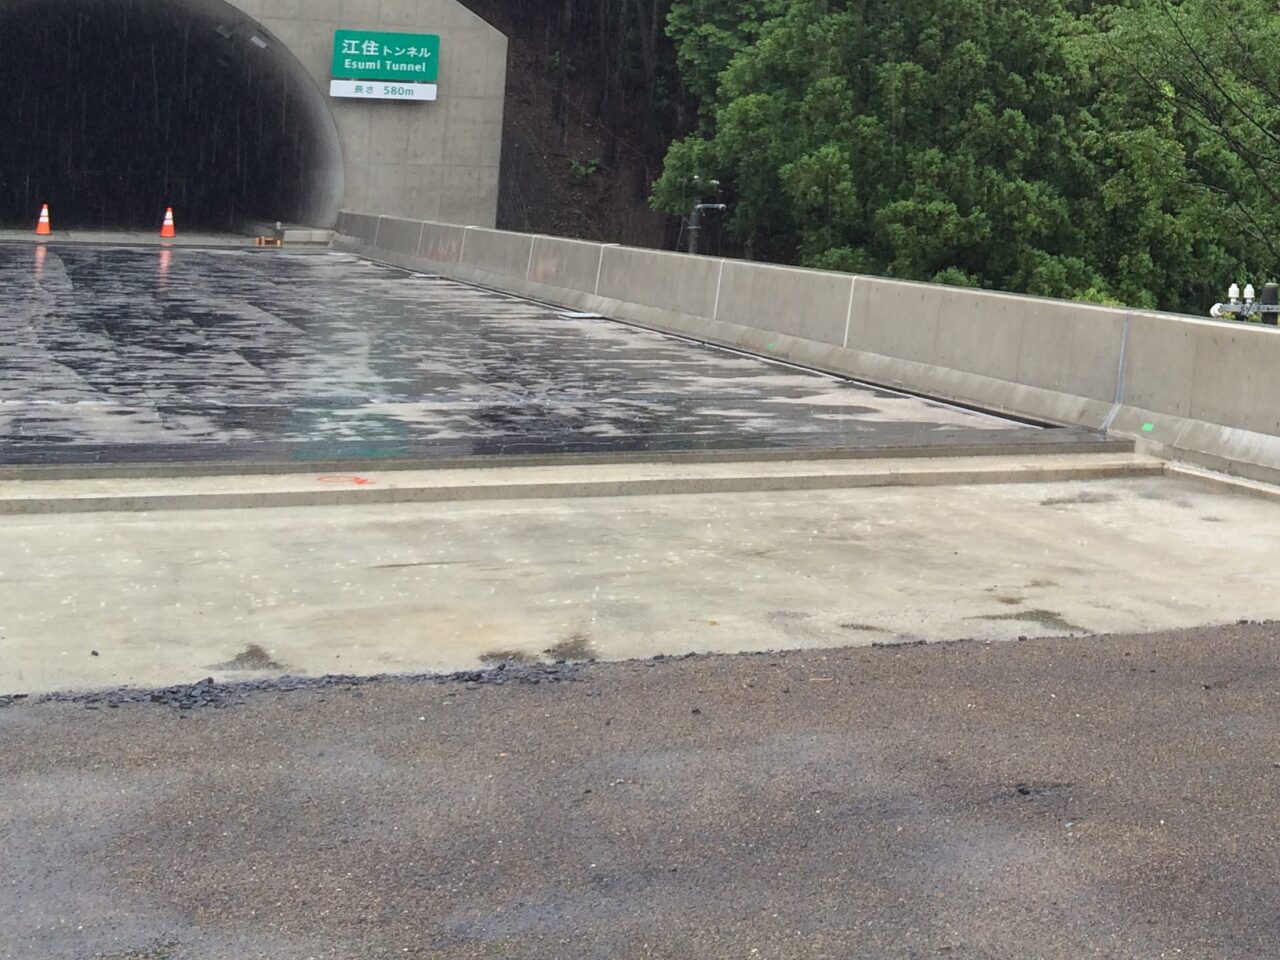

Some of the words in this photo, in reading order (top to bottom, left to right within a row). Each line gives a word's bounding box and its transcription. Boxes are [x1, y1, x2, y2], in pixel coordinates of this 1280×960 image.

[342, 39, 431, 58] 江住トンネル
[344, 58, 380, 70] Esumi
[385, 60, 426, 72] Tunnel
[383, 85, 414, 96] 580m
